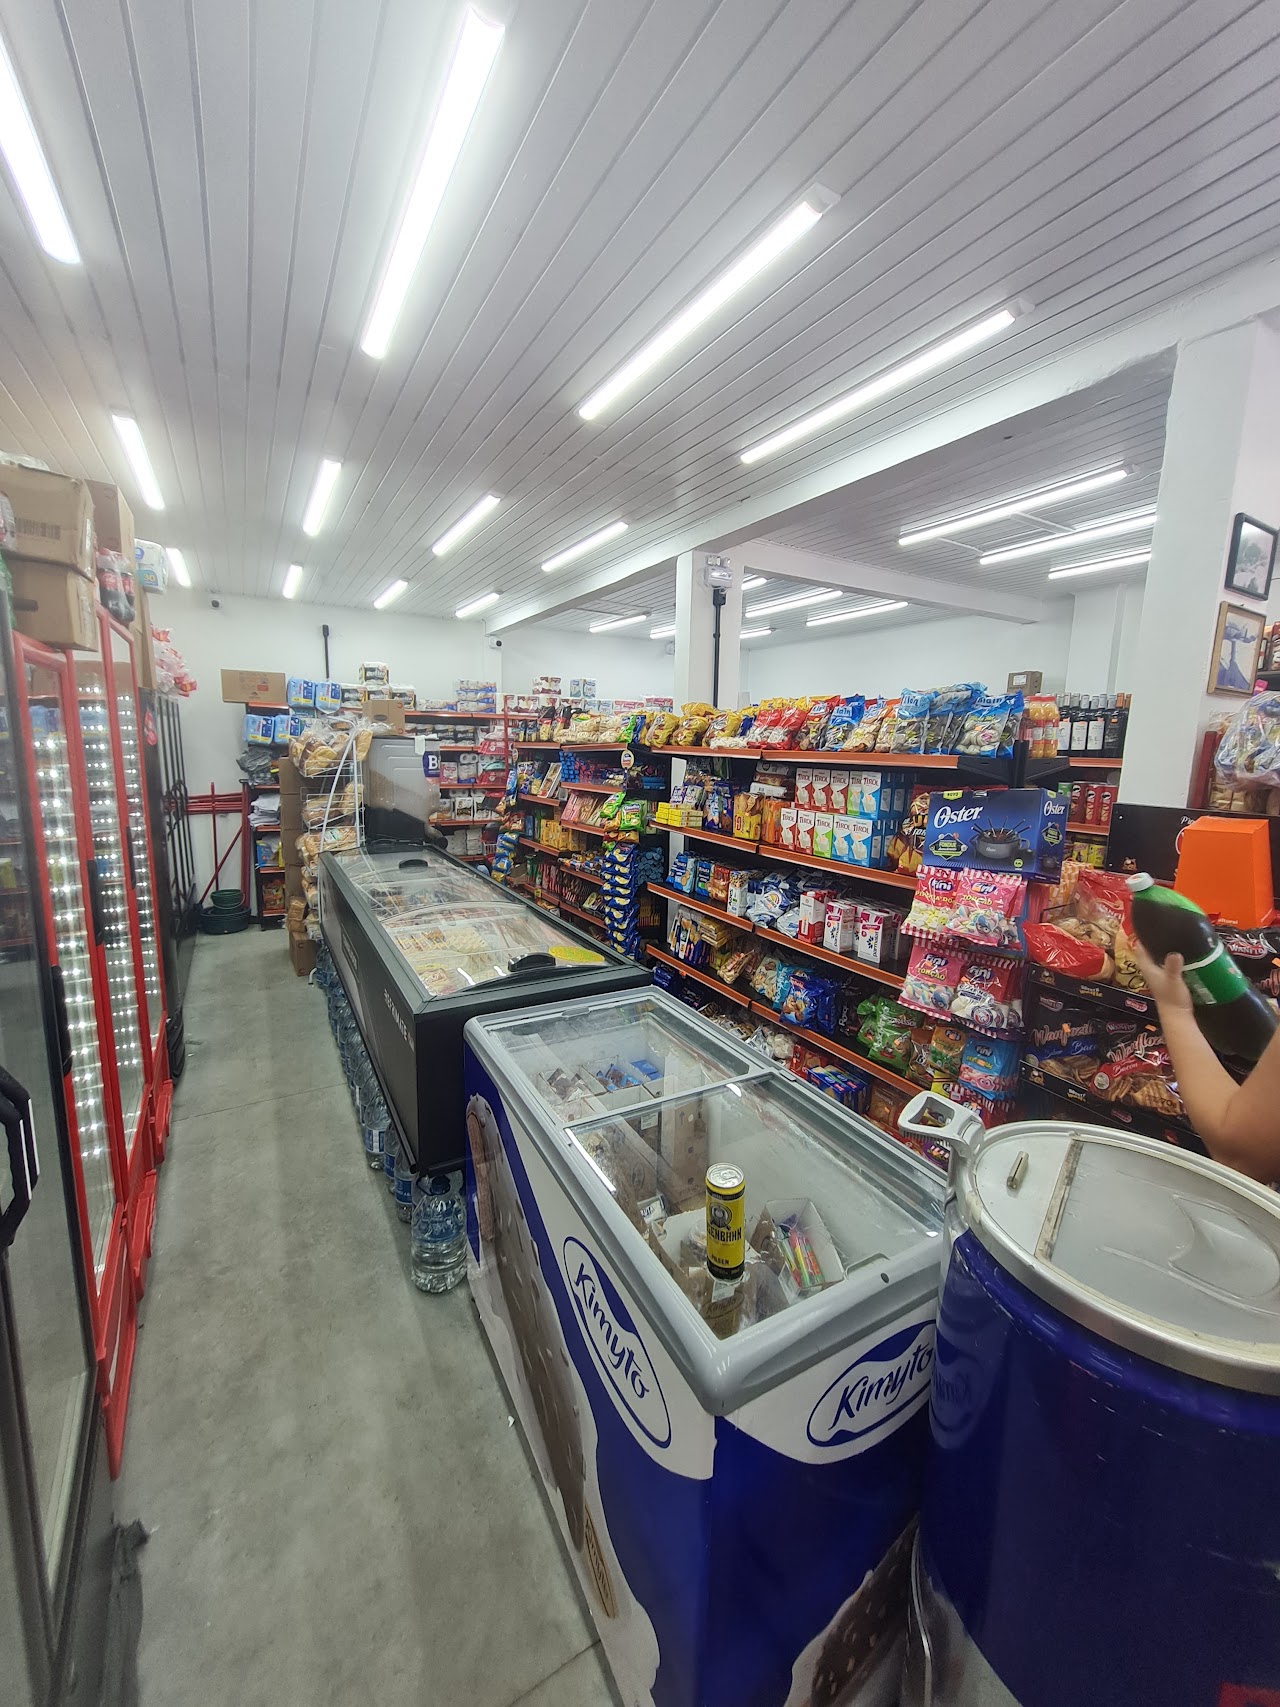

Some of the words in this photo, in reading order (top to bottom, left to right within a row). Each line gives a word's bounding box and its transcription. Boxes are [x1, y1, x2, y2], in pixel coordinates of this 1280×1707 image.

[797, 773, 811, 782] TIROL
[814, 774, 829, 784] TIROL
[832, 776, 848, 785] TIROL
[863, 777, 880, 787] TIROL
[1043, 800, 1066, 816] Oster
[782, 813, 795, 823] TIROL
[799, 816, 813, 826] TIROL
[933, 805, 984, 829] Oster
[816, 819, 832, 829] TIROL
[852, 824, 870, 835] TIROL
[917, 967, 946, 981] TORÇÃO
[574, 1262, 650, 1399] Kimyto
[828, 1342, 934, 1431] Kimyto
